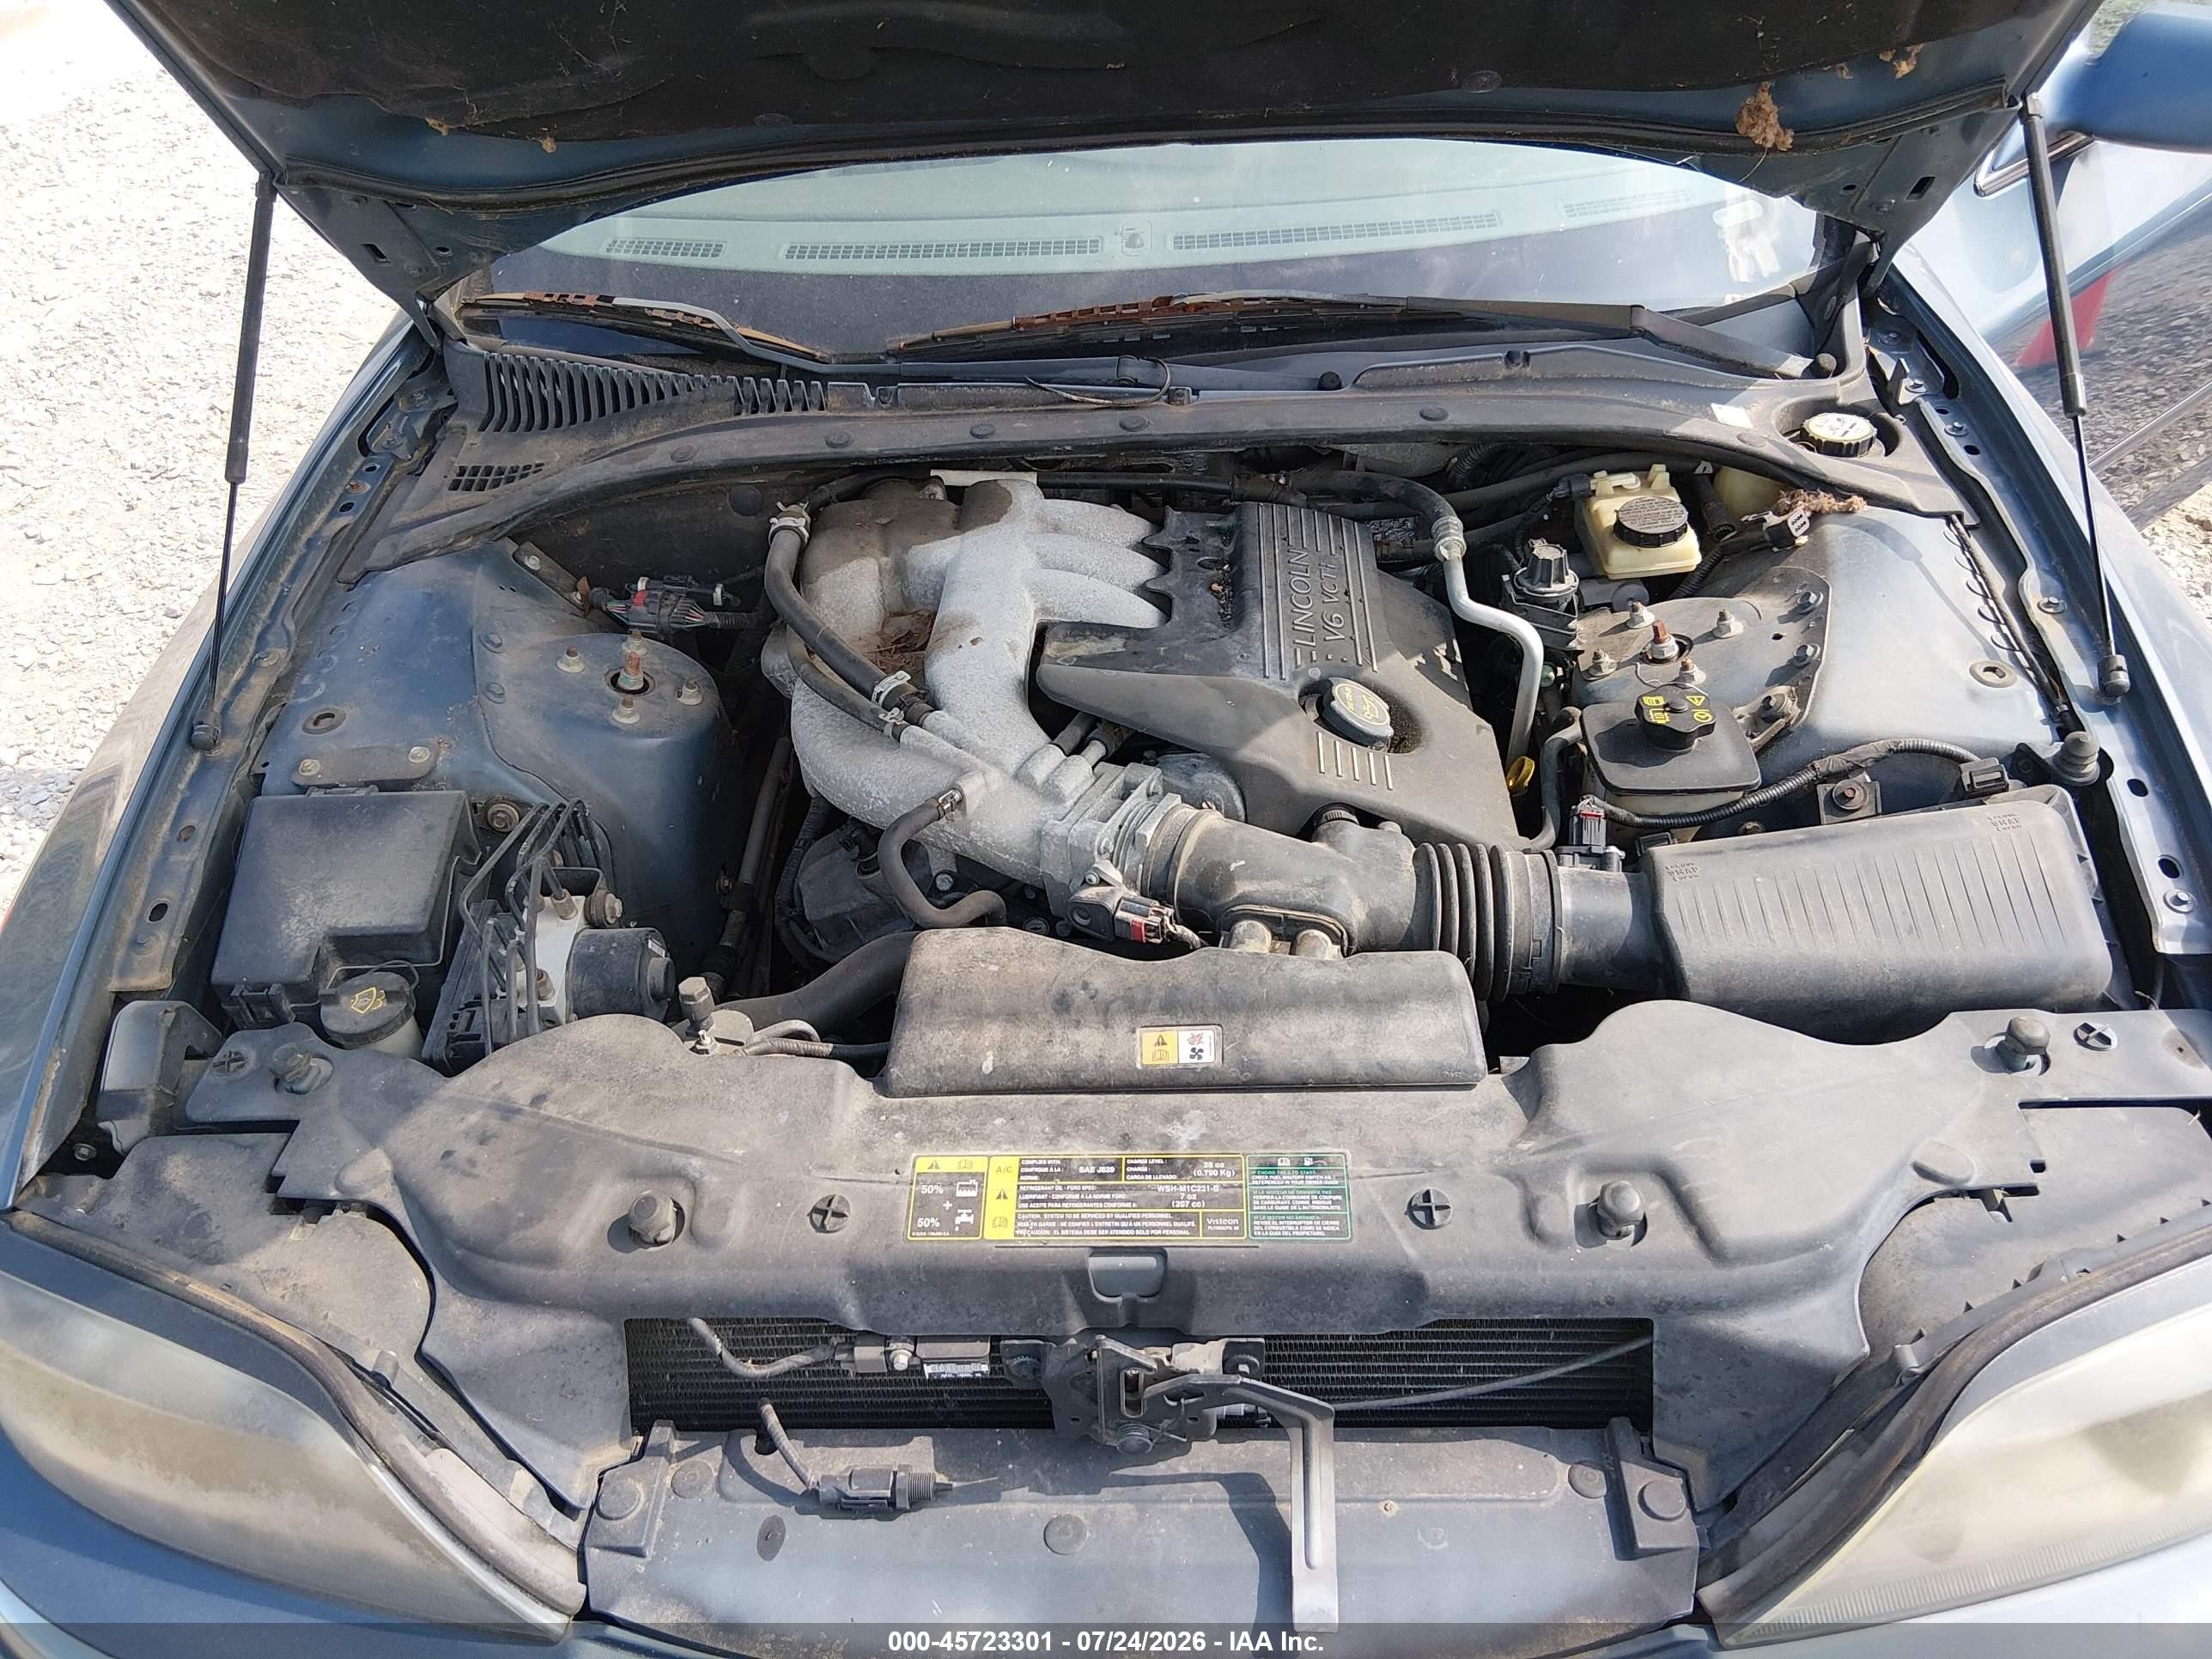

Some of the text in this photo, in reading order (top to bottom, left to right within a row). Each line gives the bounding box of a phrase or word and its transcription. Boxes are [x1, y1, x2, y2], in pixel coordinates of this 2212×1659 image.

[1288, 549, 1315, 647] LINCOLN
[1319, 562, 1345, 641] V6 VCTi
[1220, 1169, 1235, 1178] Kg)
[921, 1185, 943, 1194] 50%
[917, 1218, 940, 1228] 50%
